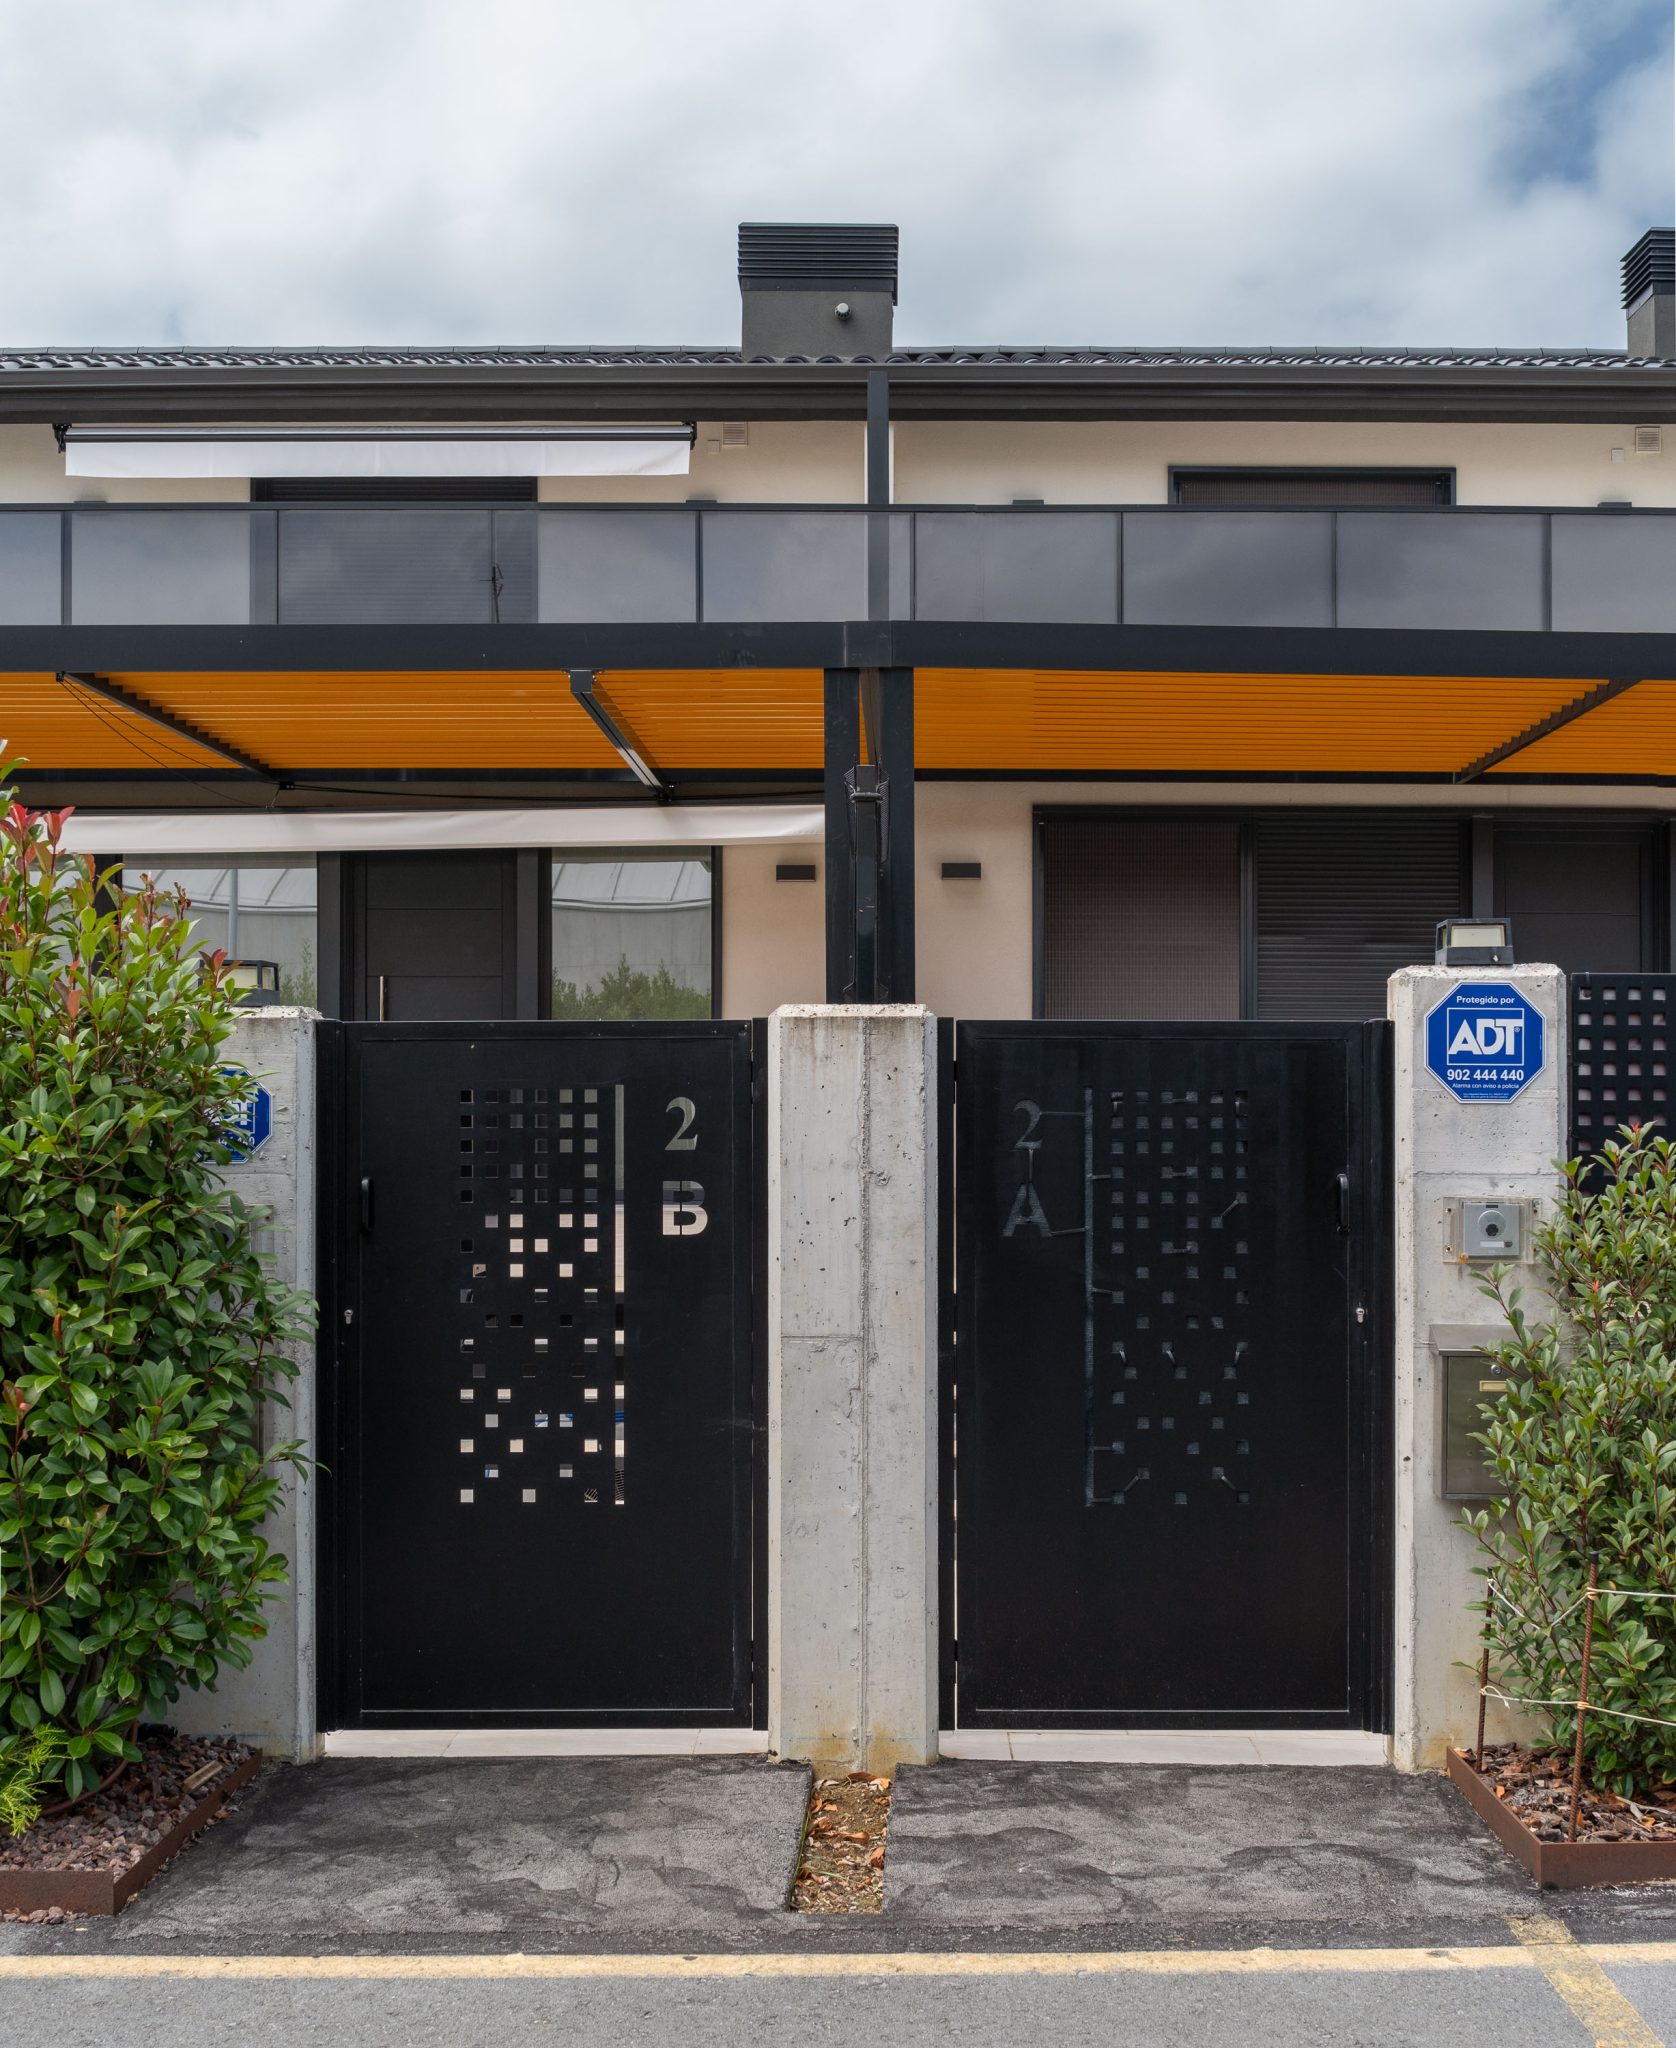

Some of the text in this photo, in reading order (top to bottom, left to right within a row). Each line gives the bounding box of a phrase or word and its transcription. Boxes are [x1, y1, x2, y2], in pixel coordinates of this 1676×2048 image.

[1456, 996, 1515, 1005] Protegido por
[1448, 1019, 1524, 1055] ADT
[1447, 1069, 1524, 1081] 902 444 440
[664, 1096, 698, 1150] 2
[1012, 1099, 1043, 1150] 2
[662, 1180, 708, 1235] B
[1001, 1182, 1052, 1237] A
